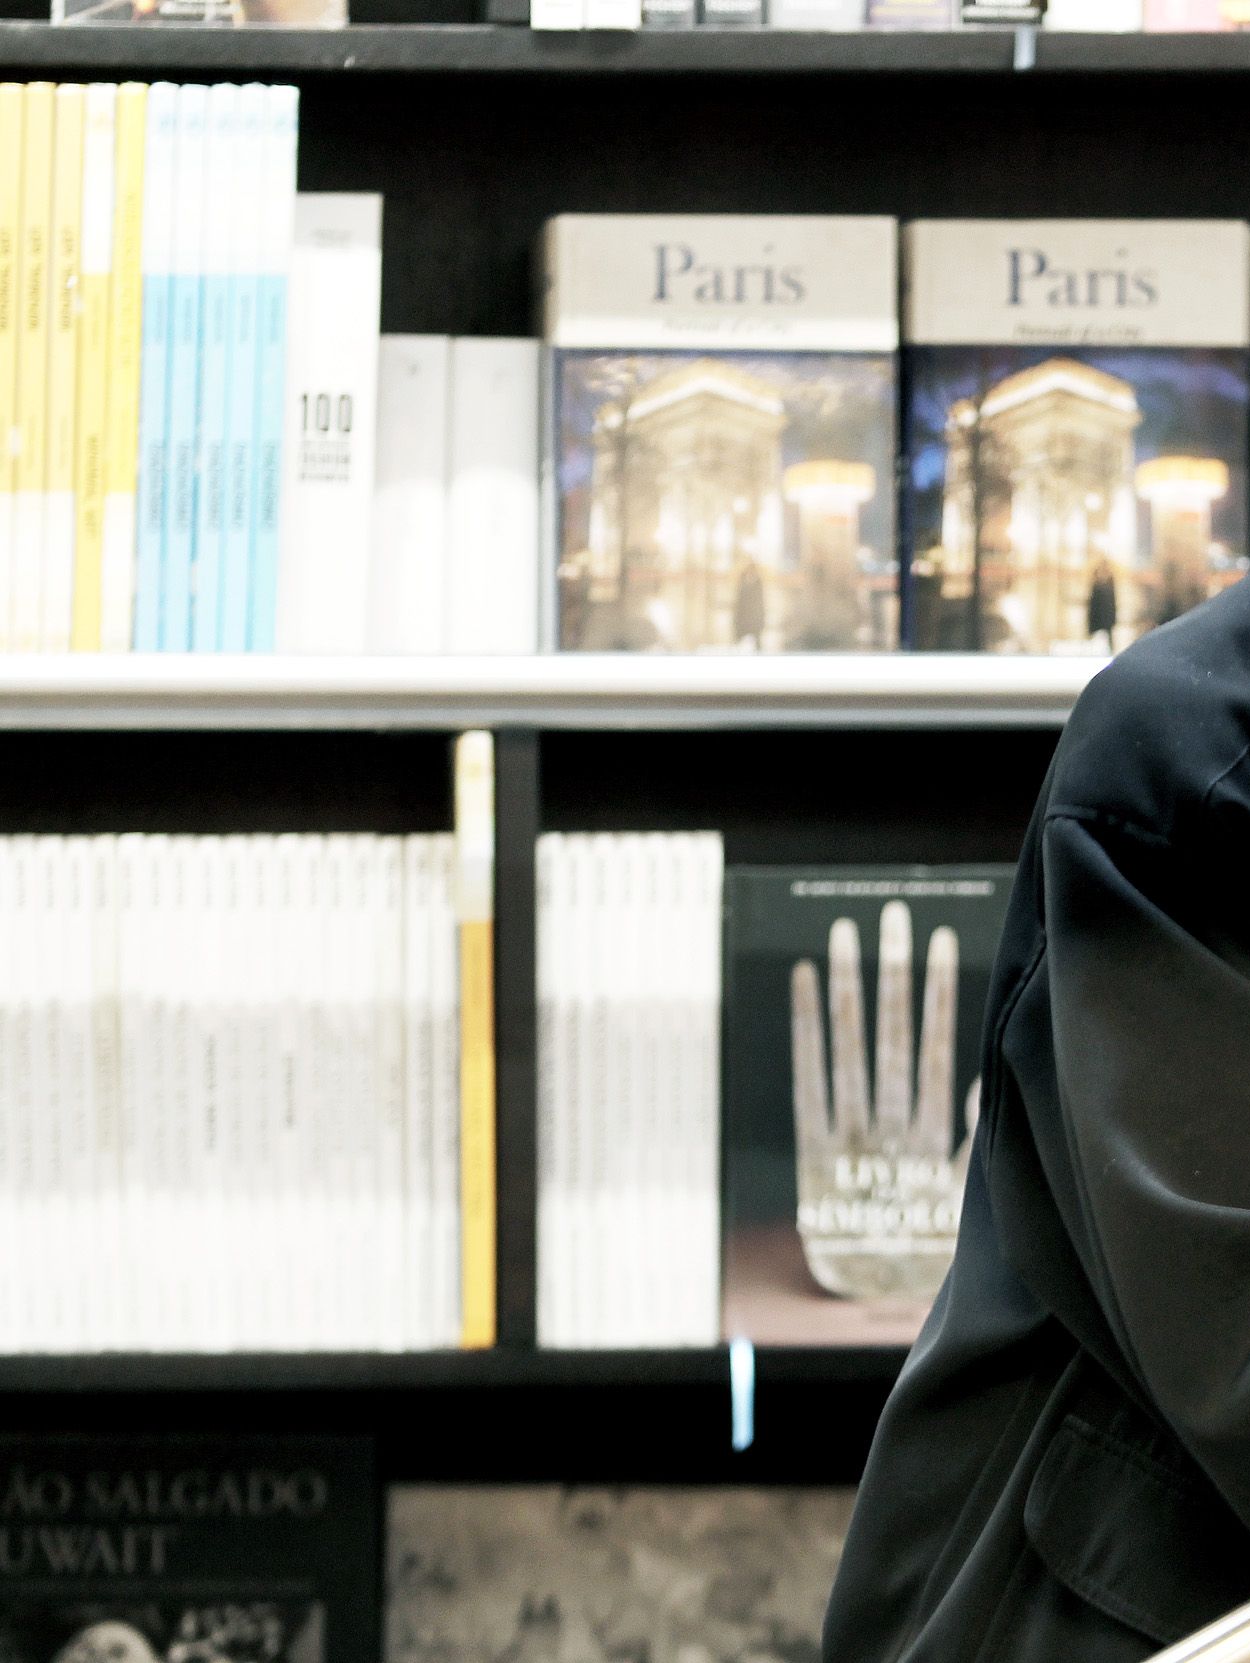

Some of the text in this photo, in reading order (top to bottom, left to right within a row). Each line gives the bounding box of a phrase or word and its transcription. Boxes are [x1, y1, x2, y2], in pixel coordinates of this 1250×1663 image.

[653, 242, 808, 304] Paris
[1005, 246, 1159, 308] Paris
[299, 393, 353, 433] 100
[84, 1470, 328, 1516] SALGADO
[0, 1526, 176, 1575] UWAIT
